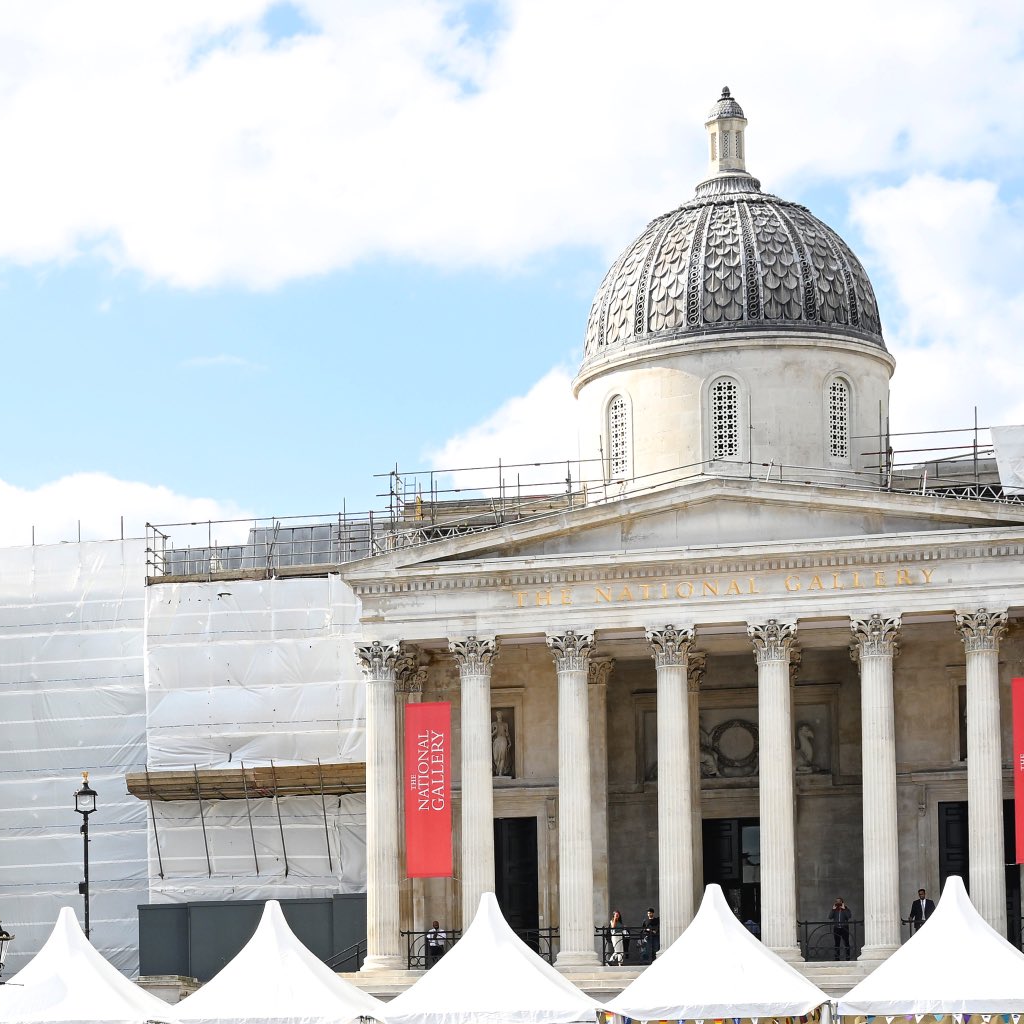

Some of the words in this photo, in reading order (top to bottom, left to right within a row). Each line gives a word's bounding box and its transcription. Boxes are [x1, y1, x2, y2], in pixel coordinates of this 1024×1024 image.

[512, 588, 573, 608] THE
[595, 576, 761, 604] NATIONAL
[784, 568, 936, 592] GALLERY
[418, 729, 430, 811] NATIONAL
[431, 730, 445, 811] GALLERY
